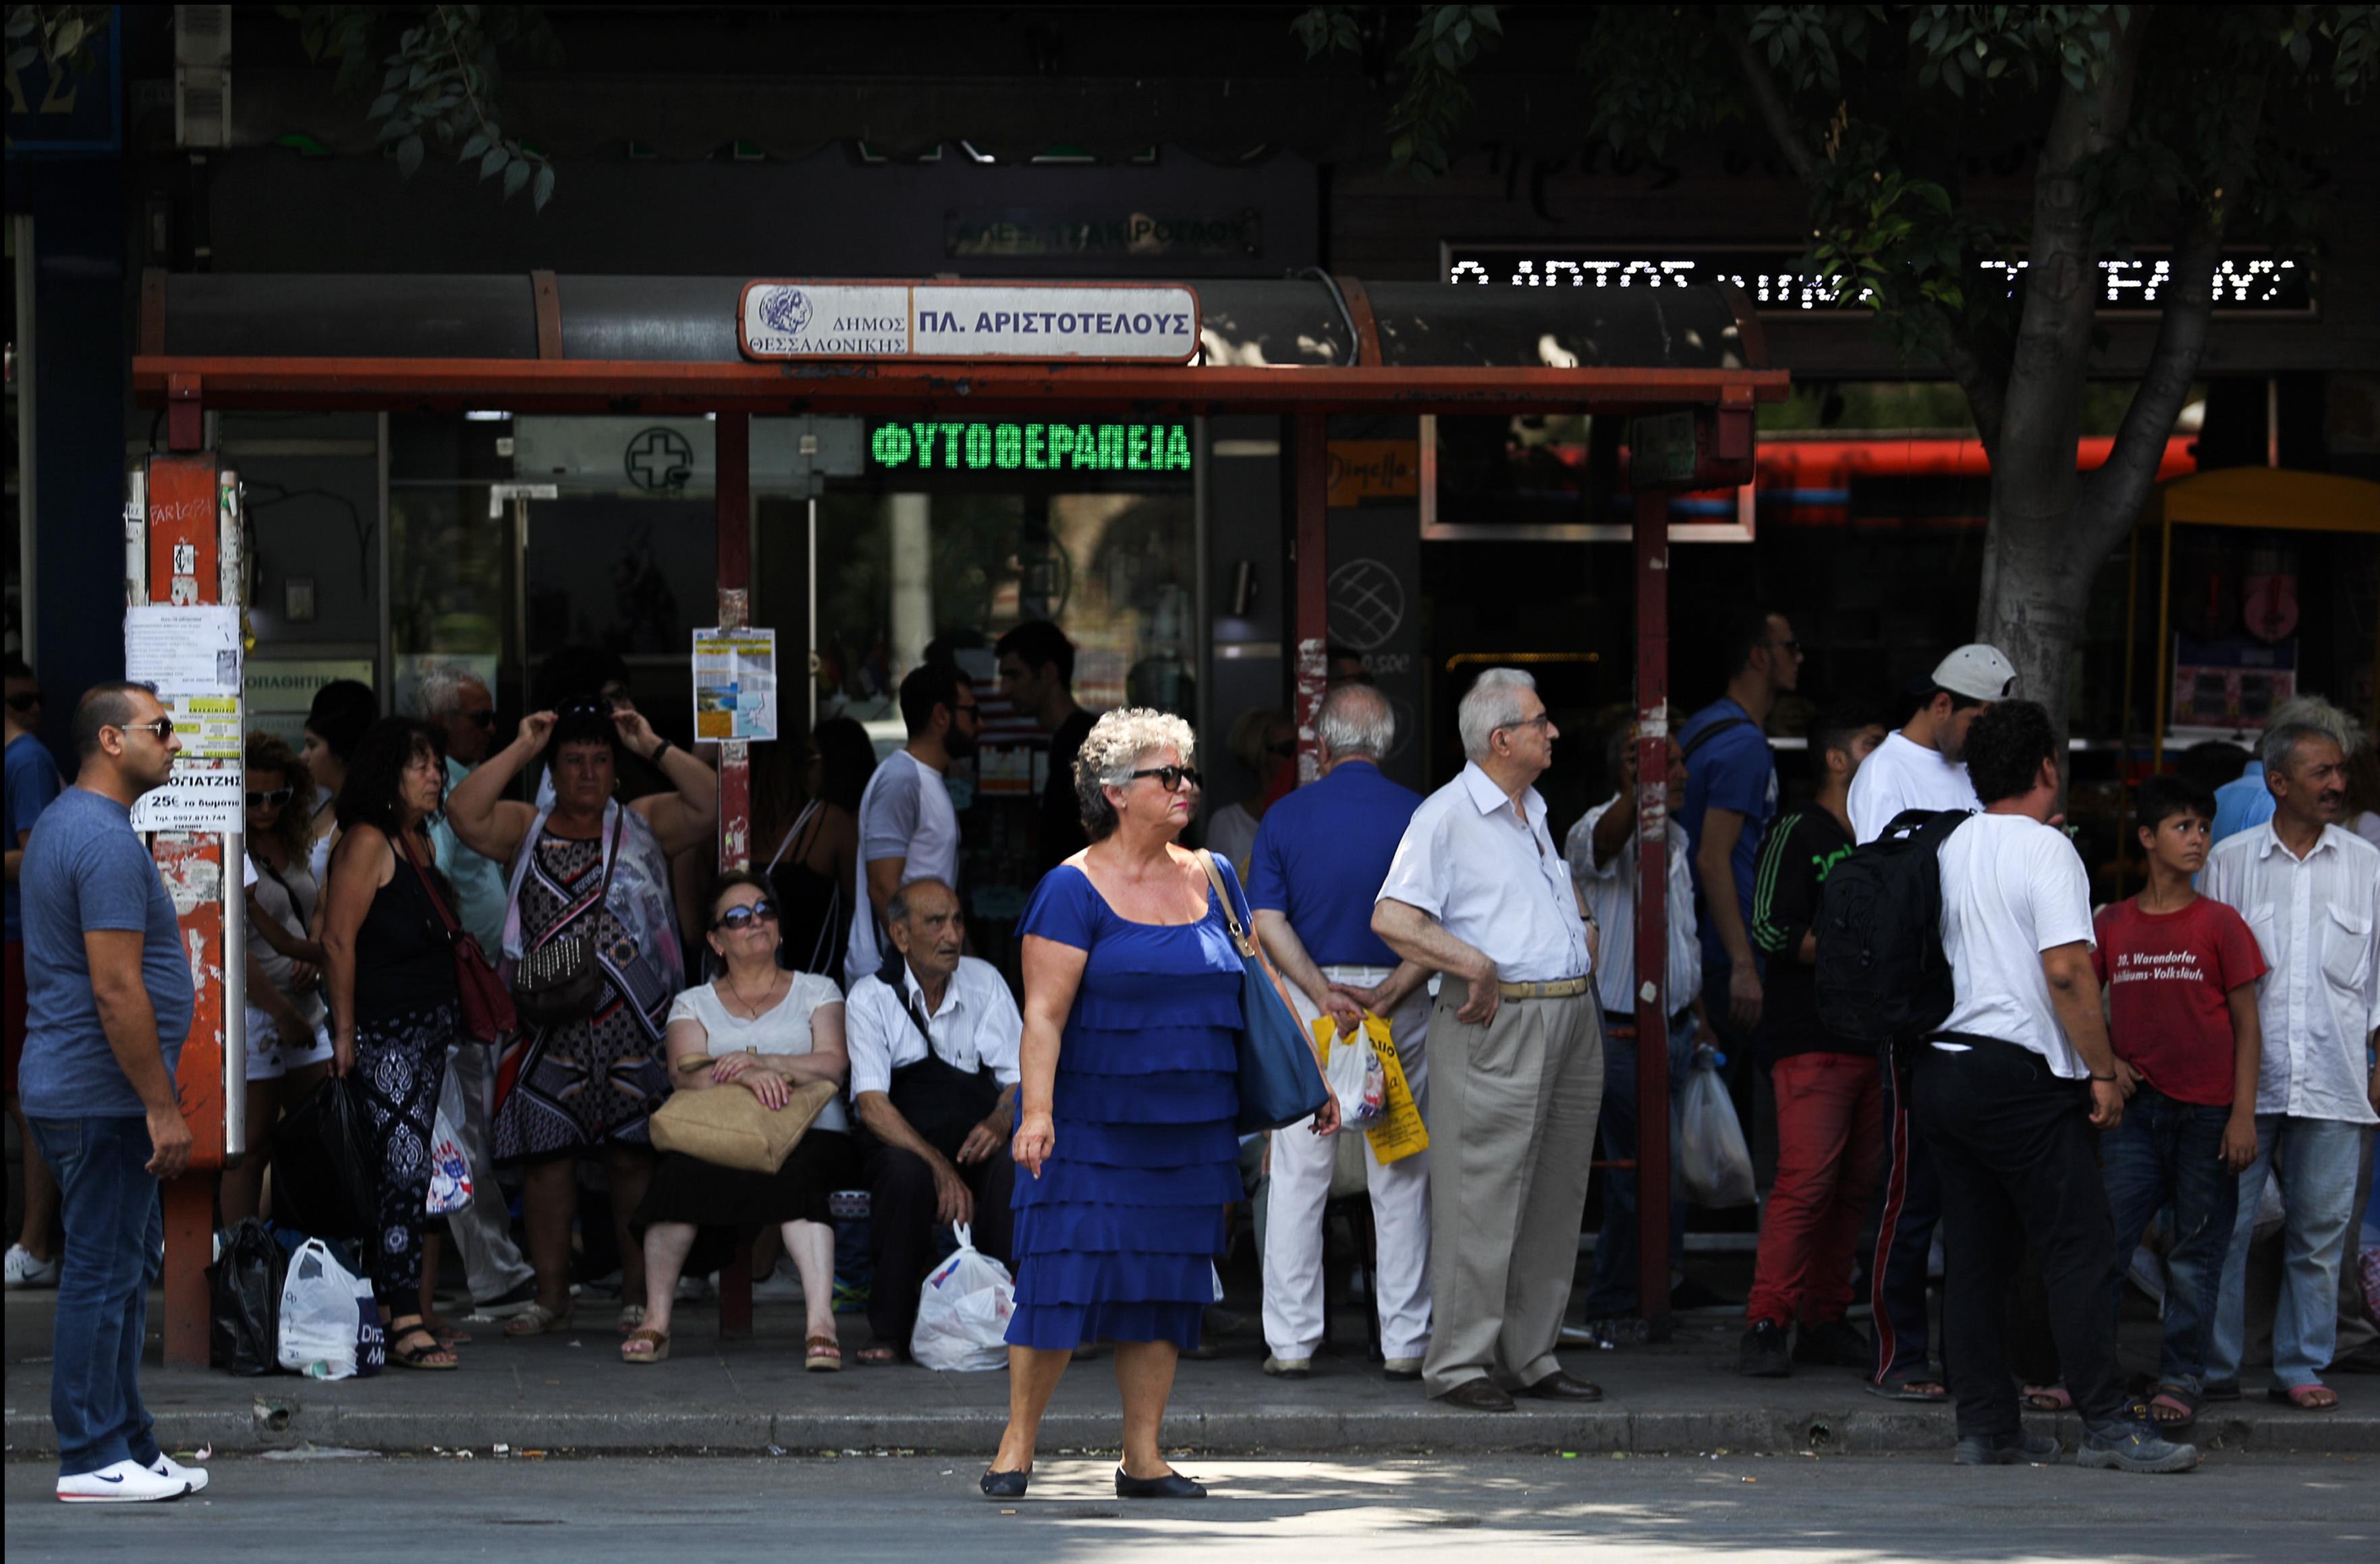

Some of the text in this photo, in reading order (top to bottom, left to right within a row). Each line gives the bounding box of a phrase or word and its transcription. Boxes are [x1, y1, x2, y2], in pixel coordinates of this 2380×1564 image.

[833, 316, 905, 333] ΔΗΜΟΣ
[918, 312, 1189, 335] ΠΛ. ΑΡΙΣΤΟΤΕΛΟΥΣ
[749, 338, 905, 354] ΘΕΣΣΑΛΟΝΙΚΗΣ
[872, 422, 1191, 470] ΦΥΤΟΘΕΡΑΠΕΙΑ
[246, 676, 337, 690] ΟΠΑΘΗΤΙΚ
[167, 775, 242, 787] ΟΓΙΑΤΖΗΣ
[153, 795, 179, 808] 25€
[2133, 950, 2197, 965] Warendorfer
